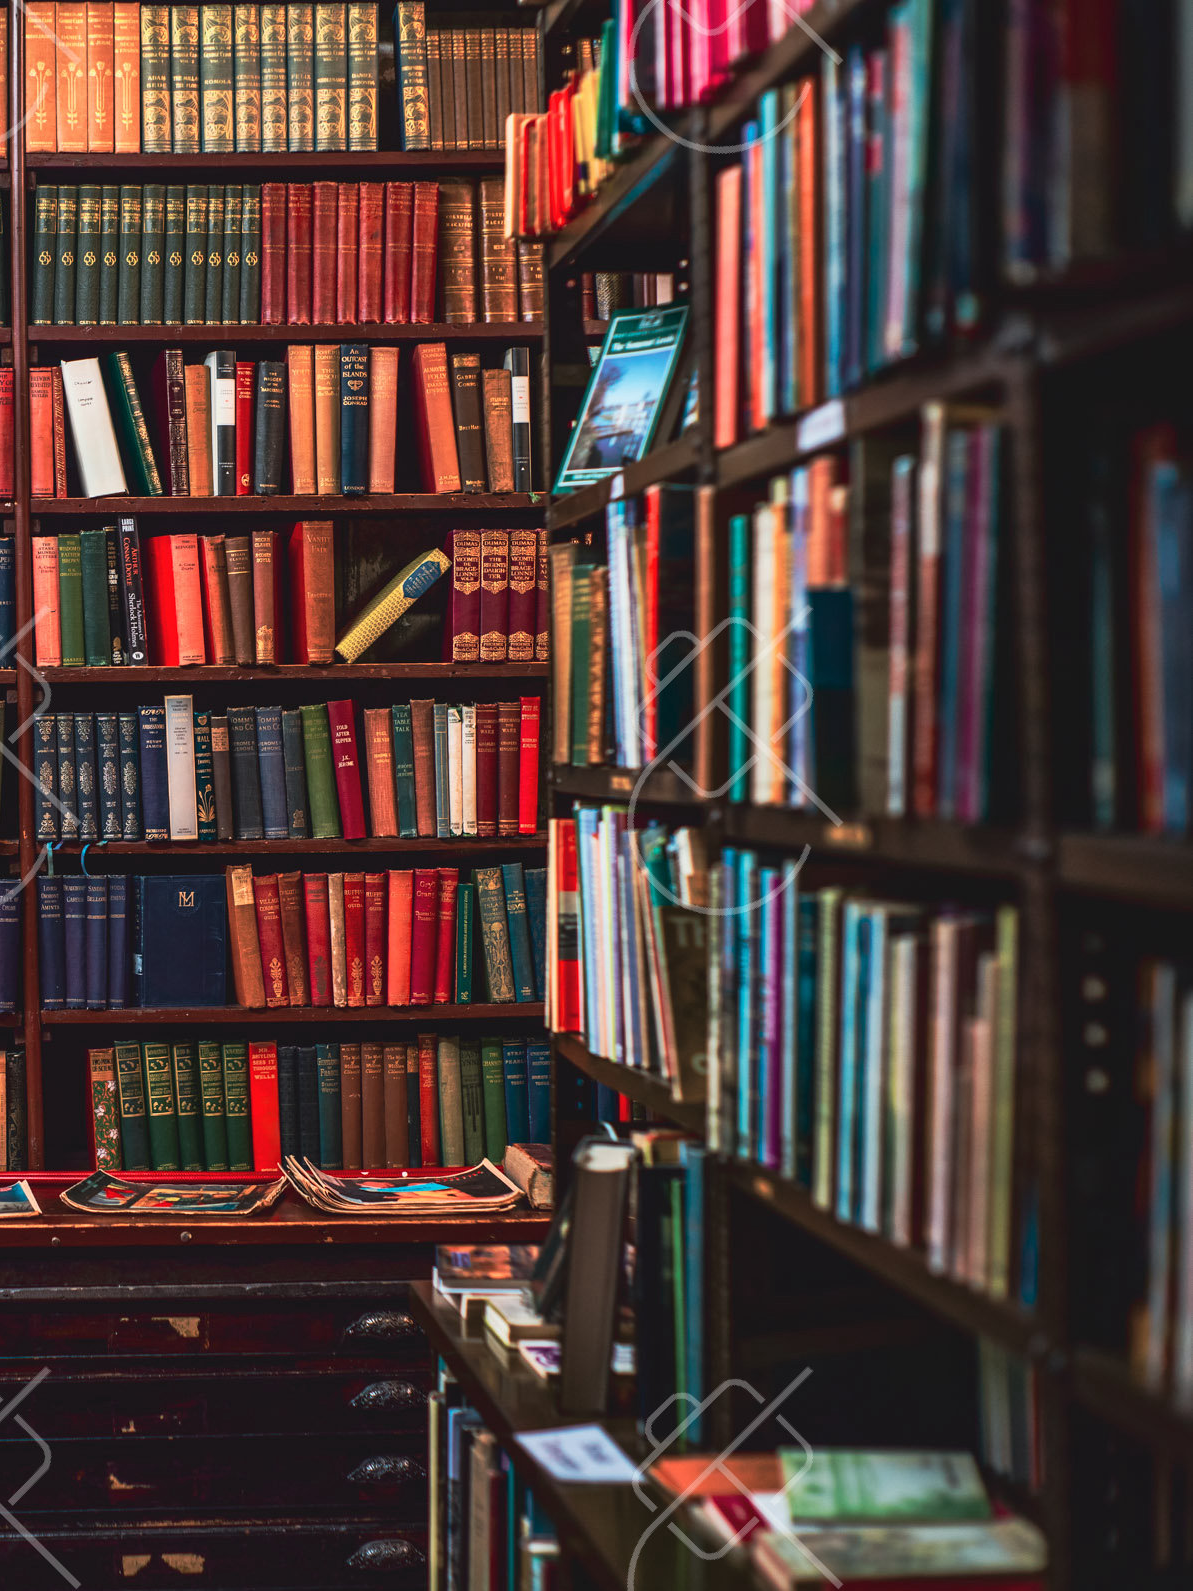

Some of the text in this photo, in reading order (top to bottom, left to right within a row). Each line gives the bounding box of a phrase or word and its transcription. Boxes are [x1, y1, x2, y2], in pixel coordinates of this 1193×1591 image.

[121, 517, 134, 525] LARGE
[122, 524, 135, 533] PRINT
[130, 547, 139, 576] ARTHUR
[124, 562, 133, 586] DOYLE
[127, 592, 138, 649] Sherlock Holmes
[338, 760, 355, 768] JEROME
